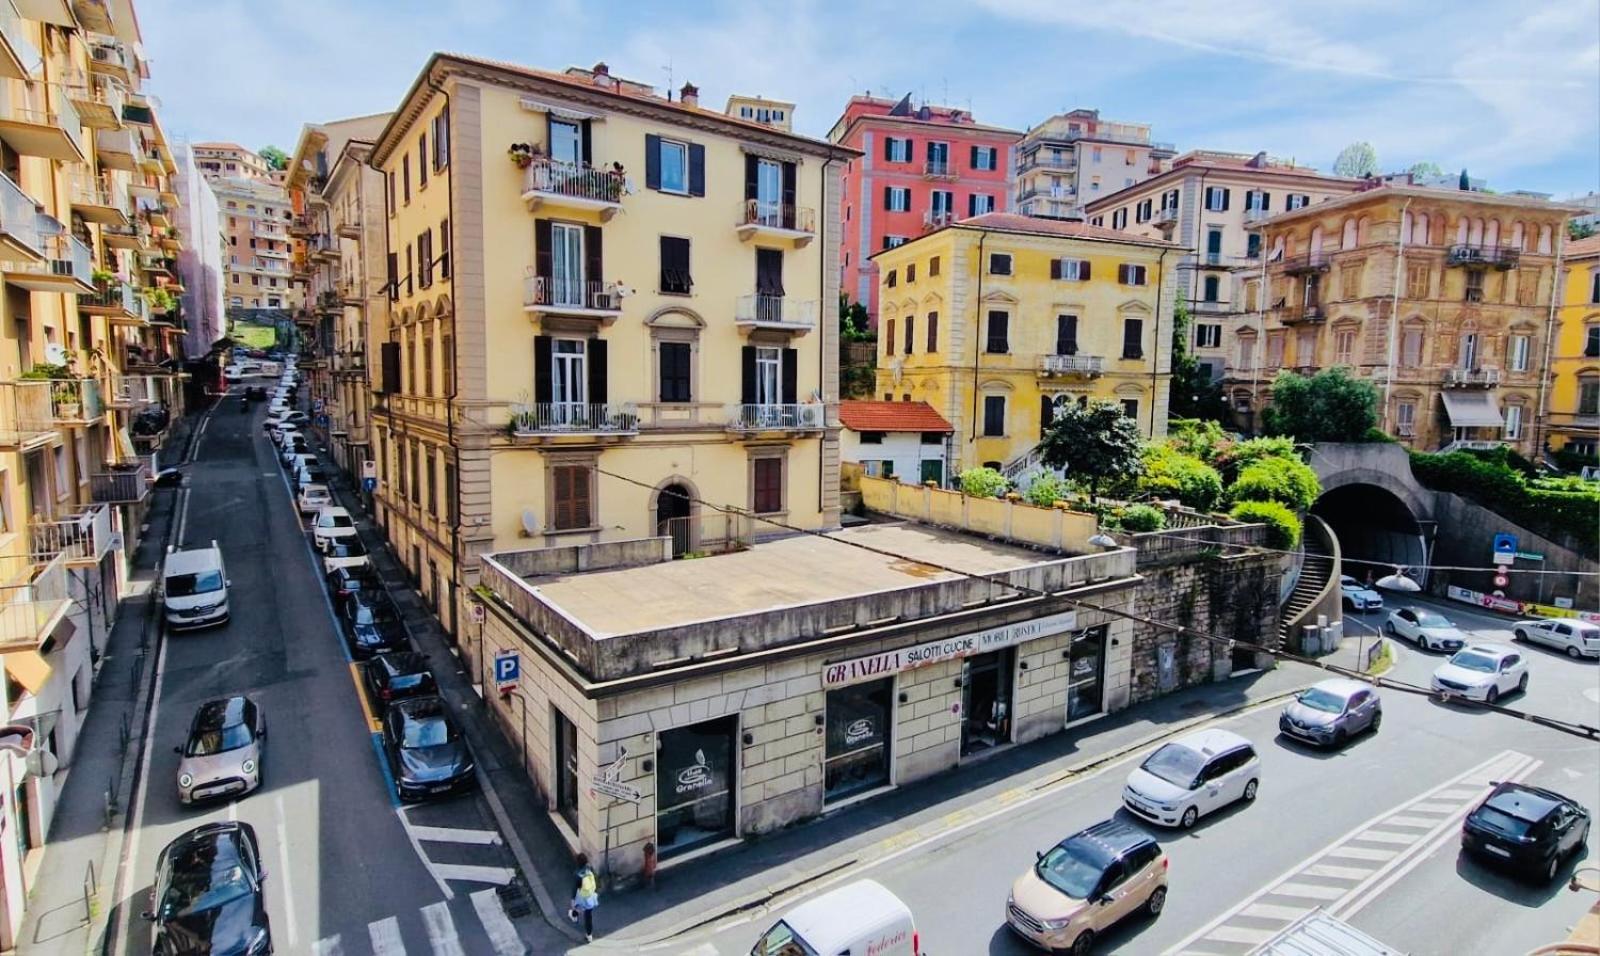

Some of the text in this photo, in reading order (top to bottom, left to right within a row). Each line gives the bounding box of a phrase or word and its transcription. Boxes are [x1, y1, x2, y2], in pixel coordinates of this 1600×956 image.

[500, 659, 516, 679] P
[826, 653, 900, 684] GRANELLA
[907, 645, 941, 664] SALOTTI
[943, 638, 974, 654] CUCINE
[675, 775, 713, 793] Granella
